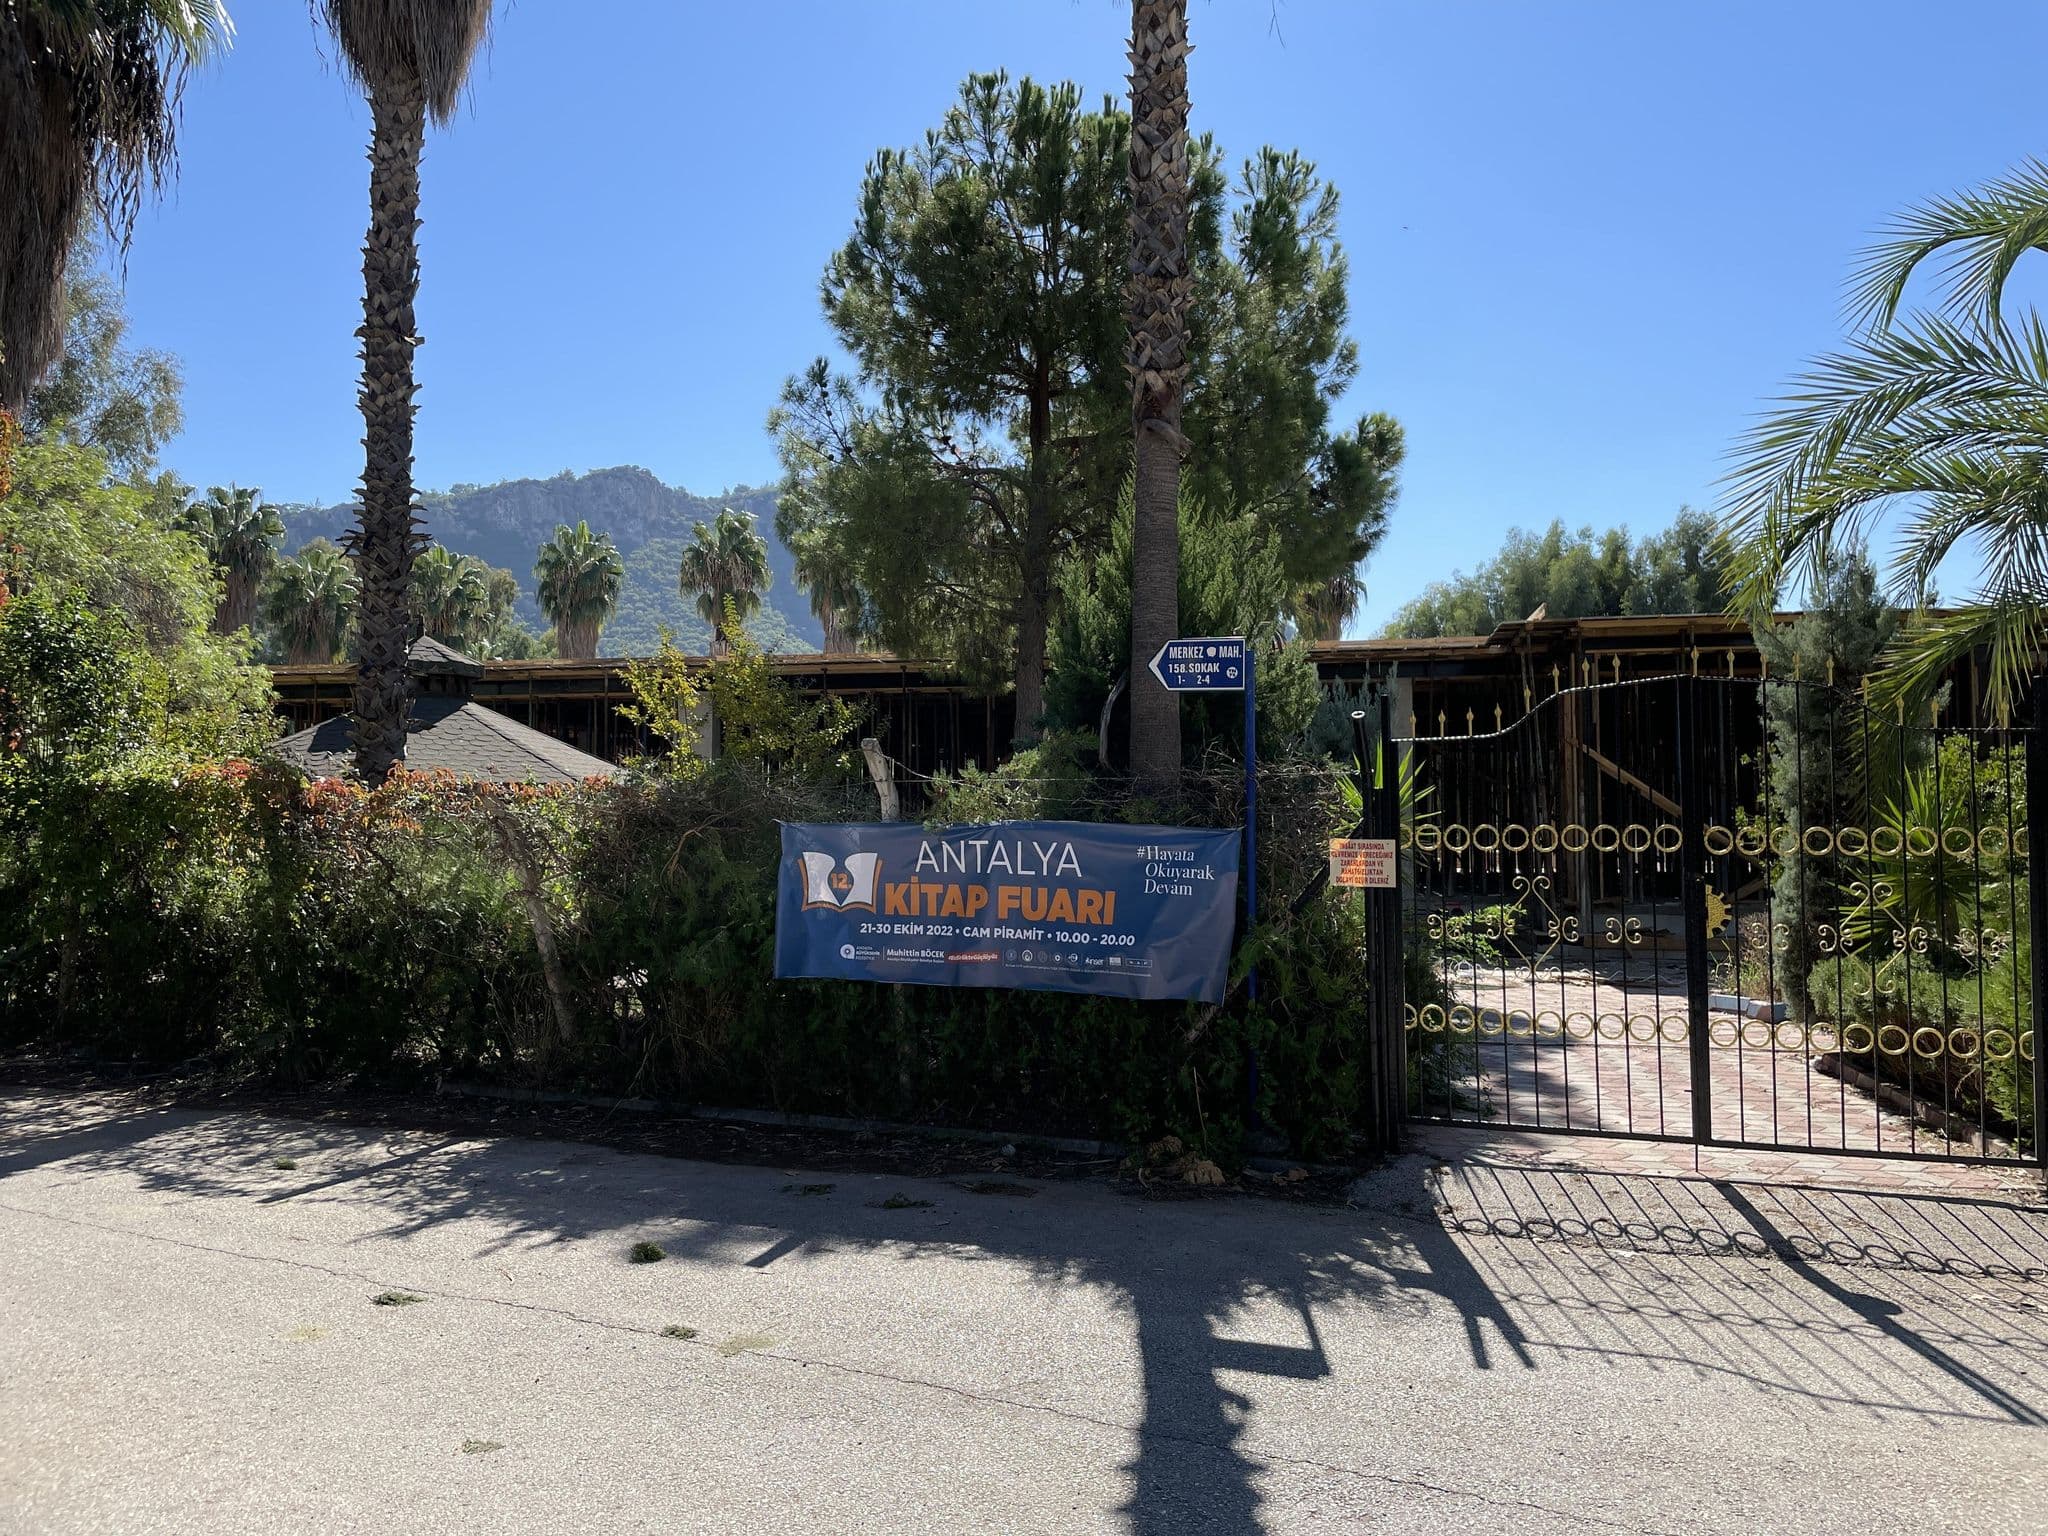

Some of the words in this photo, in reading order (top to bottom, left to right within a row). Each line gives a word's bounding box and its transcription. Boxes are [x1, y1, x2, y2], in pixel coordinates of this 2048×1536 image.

[1169, 646, 1204, 659] MERKEZ
[1219, 646, 1242, 658] MAH.
[1196, 675, 1210, 685] 2-4
[915, 840, 1082, 877] ANTALYA
[1136, 845, 1195, 865] #Hayata
[1145, 862, 1215, 882] Okuyarak
[1144, 879, 1193, 896] Devam
[884, 875, 989, 917] KİTAP
[997, 885, 1116, 926] FUARI
[860, 923, 891, 934] 21-30
[893, 922, 924, 935] EKİM
[926, 924, 953, 936] 2022
[962, 926, 990, 938] CAM
[993, 926, 1045, 941] PİRAMİT
[1055, 931, 1090, 944] 10.00
[1099, 934, 1136, 946] 20.00
[886, 948, 920, 958] Muhittin
[920, 948, 945, 958] BÖCEK
